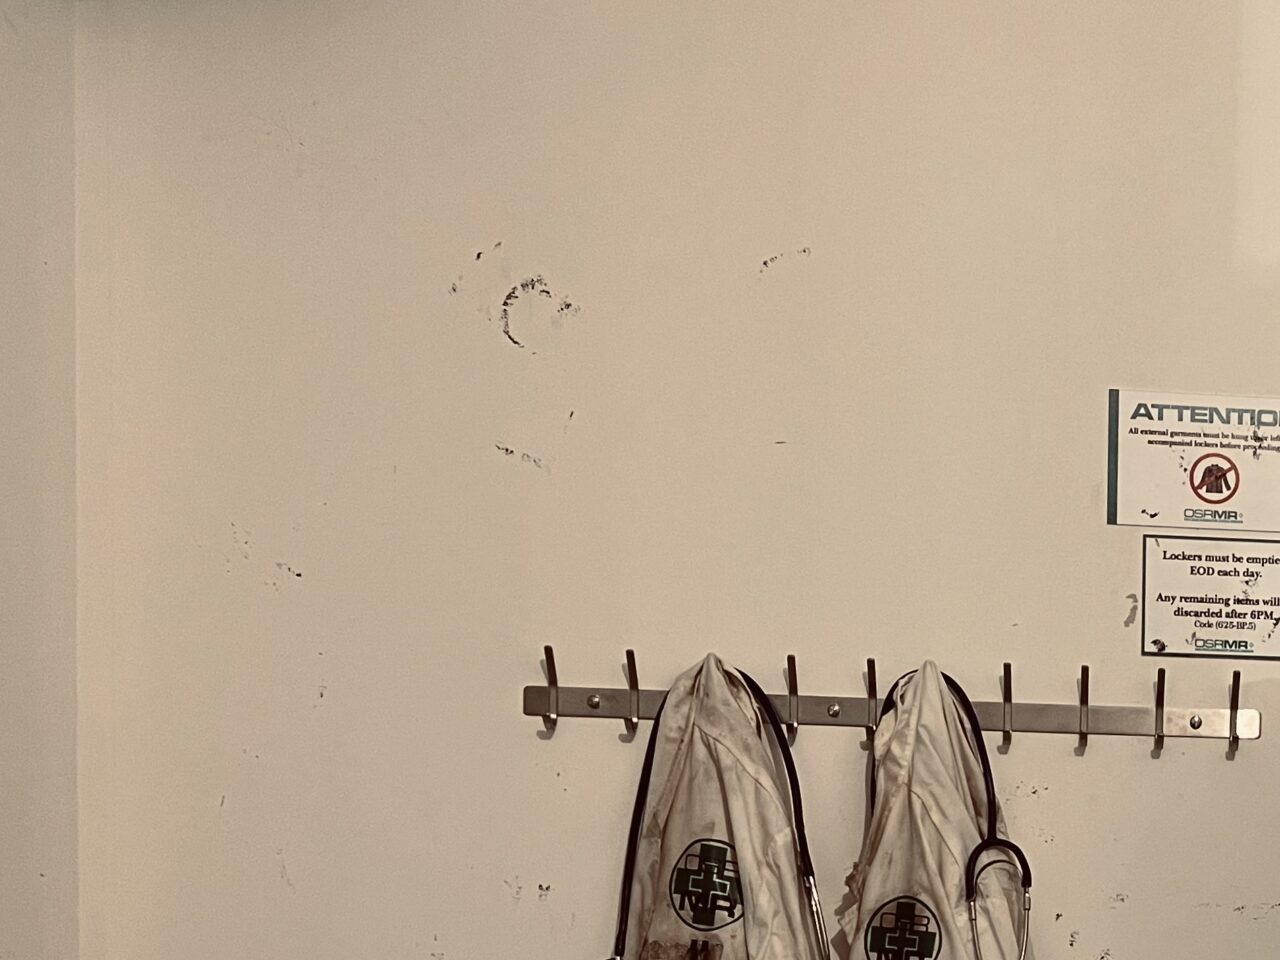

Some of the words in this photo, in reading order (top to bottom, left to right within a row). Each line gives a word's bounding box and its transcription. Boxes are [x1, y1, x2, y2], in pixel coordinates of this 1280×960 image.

[1128, 427, 1139, 435] All
[1140, 428, 1168, 438] external
[1170, 430, 1201, 439] garments
[1221, 432, 1229, 440] be
[1231, 432, 1248, 442] hung
[1270, 434, 1280, 442] left
[1147, 438, 1192, 448] accompanied
[1194, 440, 1218, 449] lockers
[1220, 441, 1242, 450] before
[1184, 508, 1238, 520] OSRMR
[1162, 550, 1202, 563] Lockers
[1205, 554, 1230, 563] must
[1232, 553, 1244, 564] be
[1190, 566, 1215, 576] EOD
[1217, 567, 1240, 577] each
[1242, 568, 1262, 579] day.
[1156, 592, 1176, 604] Any
[1180, 595, 1230, 607] remaining
[1233, 597, 1260, 606] items
[1262, 597, 1280, 607] will
[1173, 607, 1222, 618] discarded
[1224, 609, 1248, 619] after
[1194, 620, 1213, 629] Code
[1195, 638, 1248, 650] OSRMR
